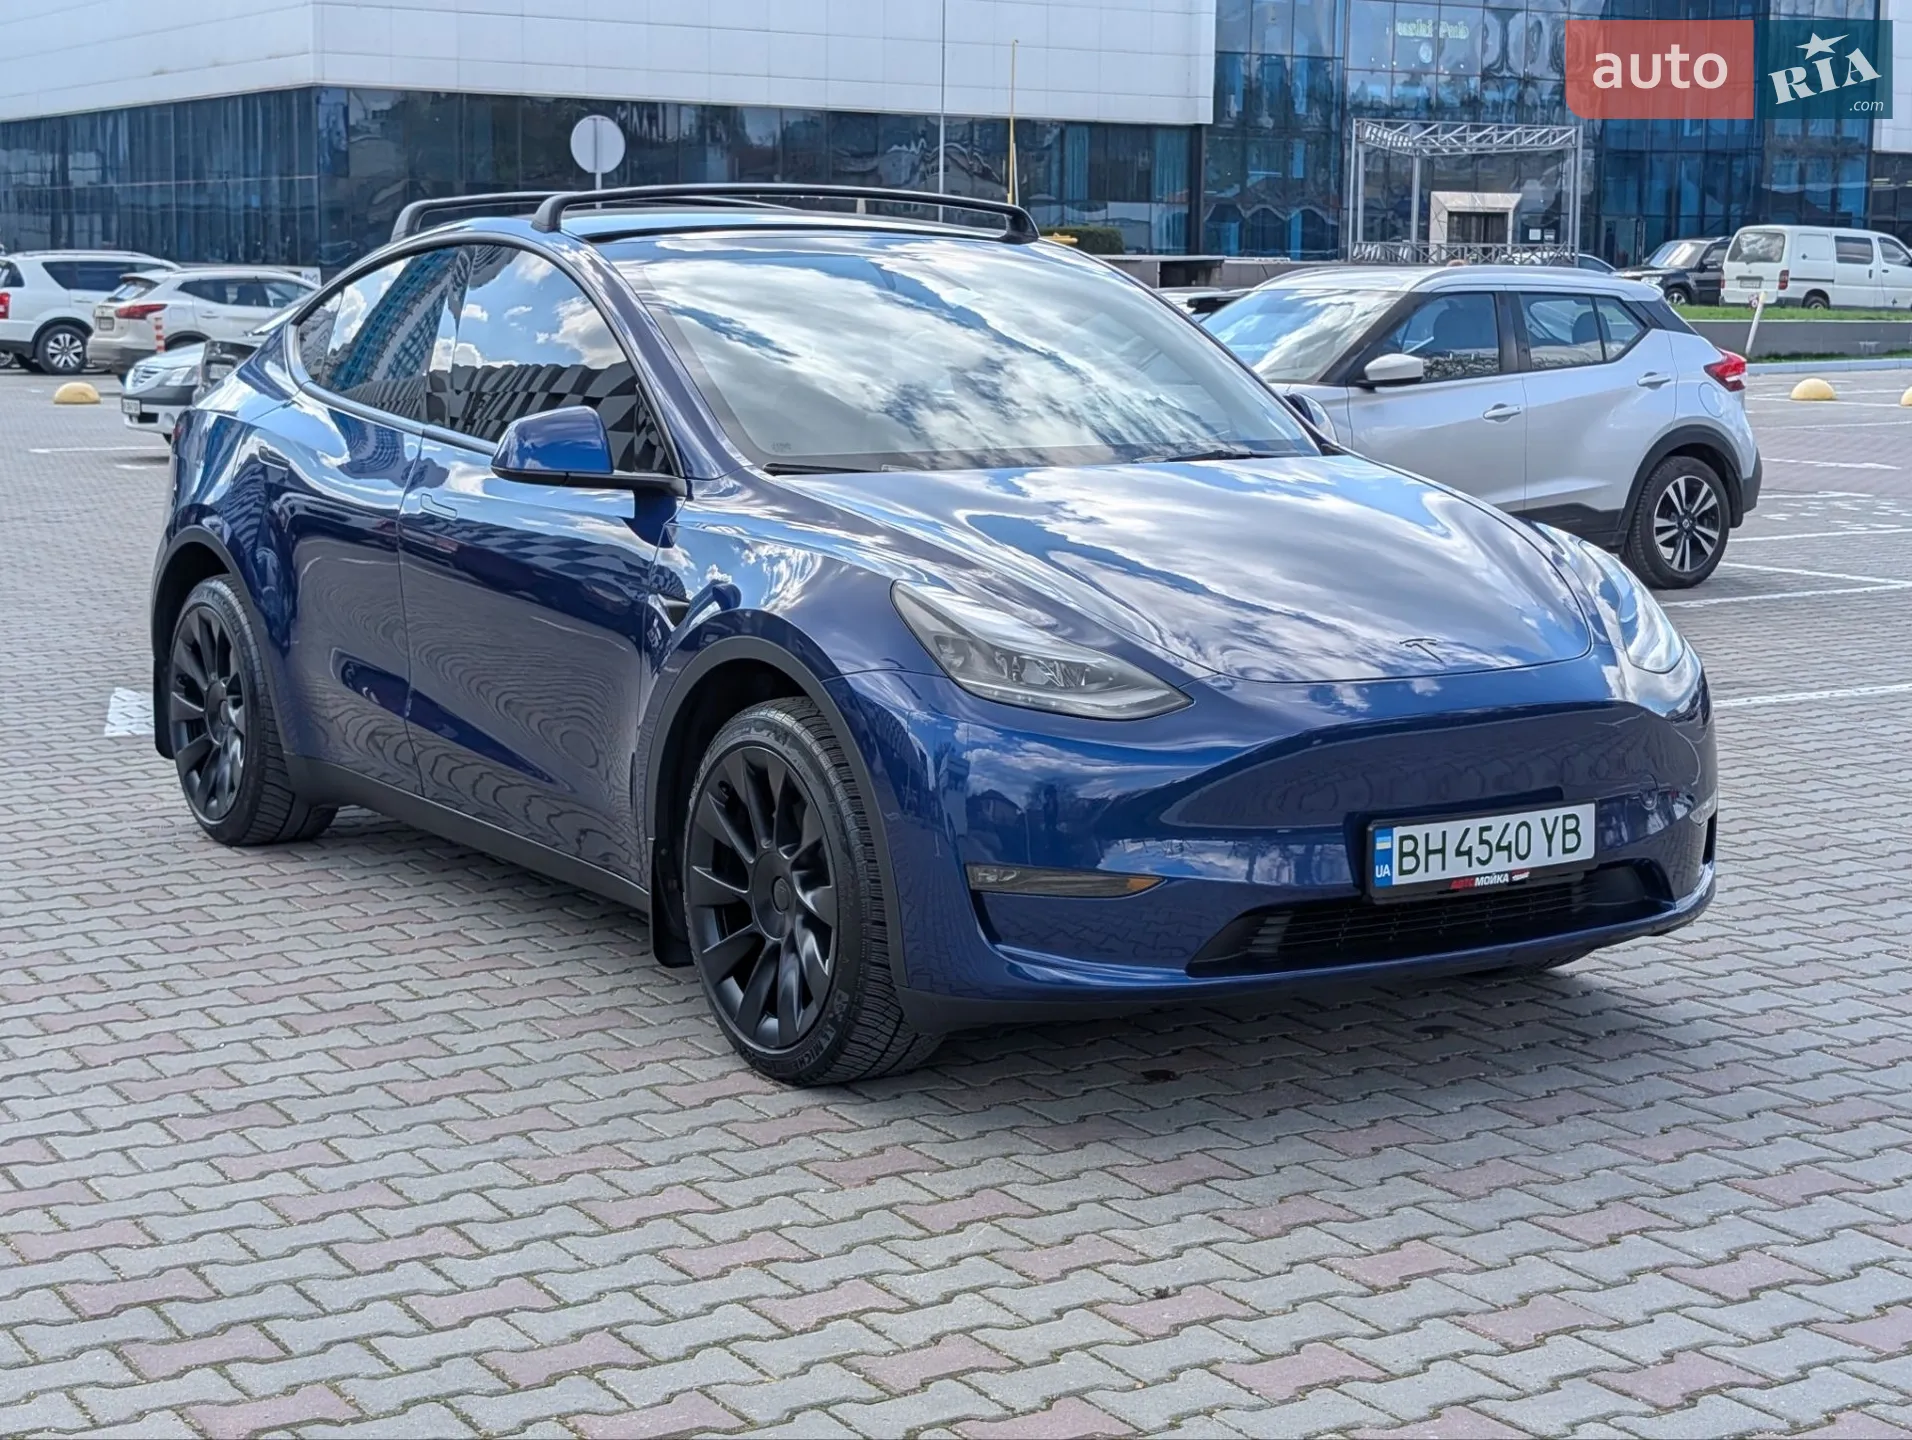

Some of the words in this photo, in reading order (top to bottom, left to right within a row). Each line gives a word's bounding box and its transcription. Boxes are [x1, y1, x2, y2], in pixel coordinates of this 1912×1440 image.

[1398, 830, 1447, 876] BH
[1455, 821, 1532, 868] 4540
[1541, 813, 1582, 858] YB
[1375, 864, 1391, 878] UA
